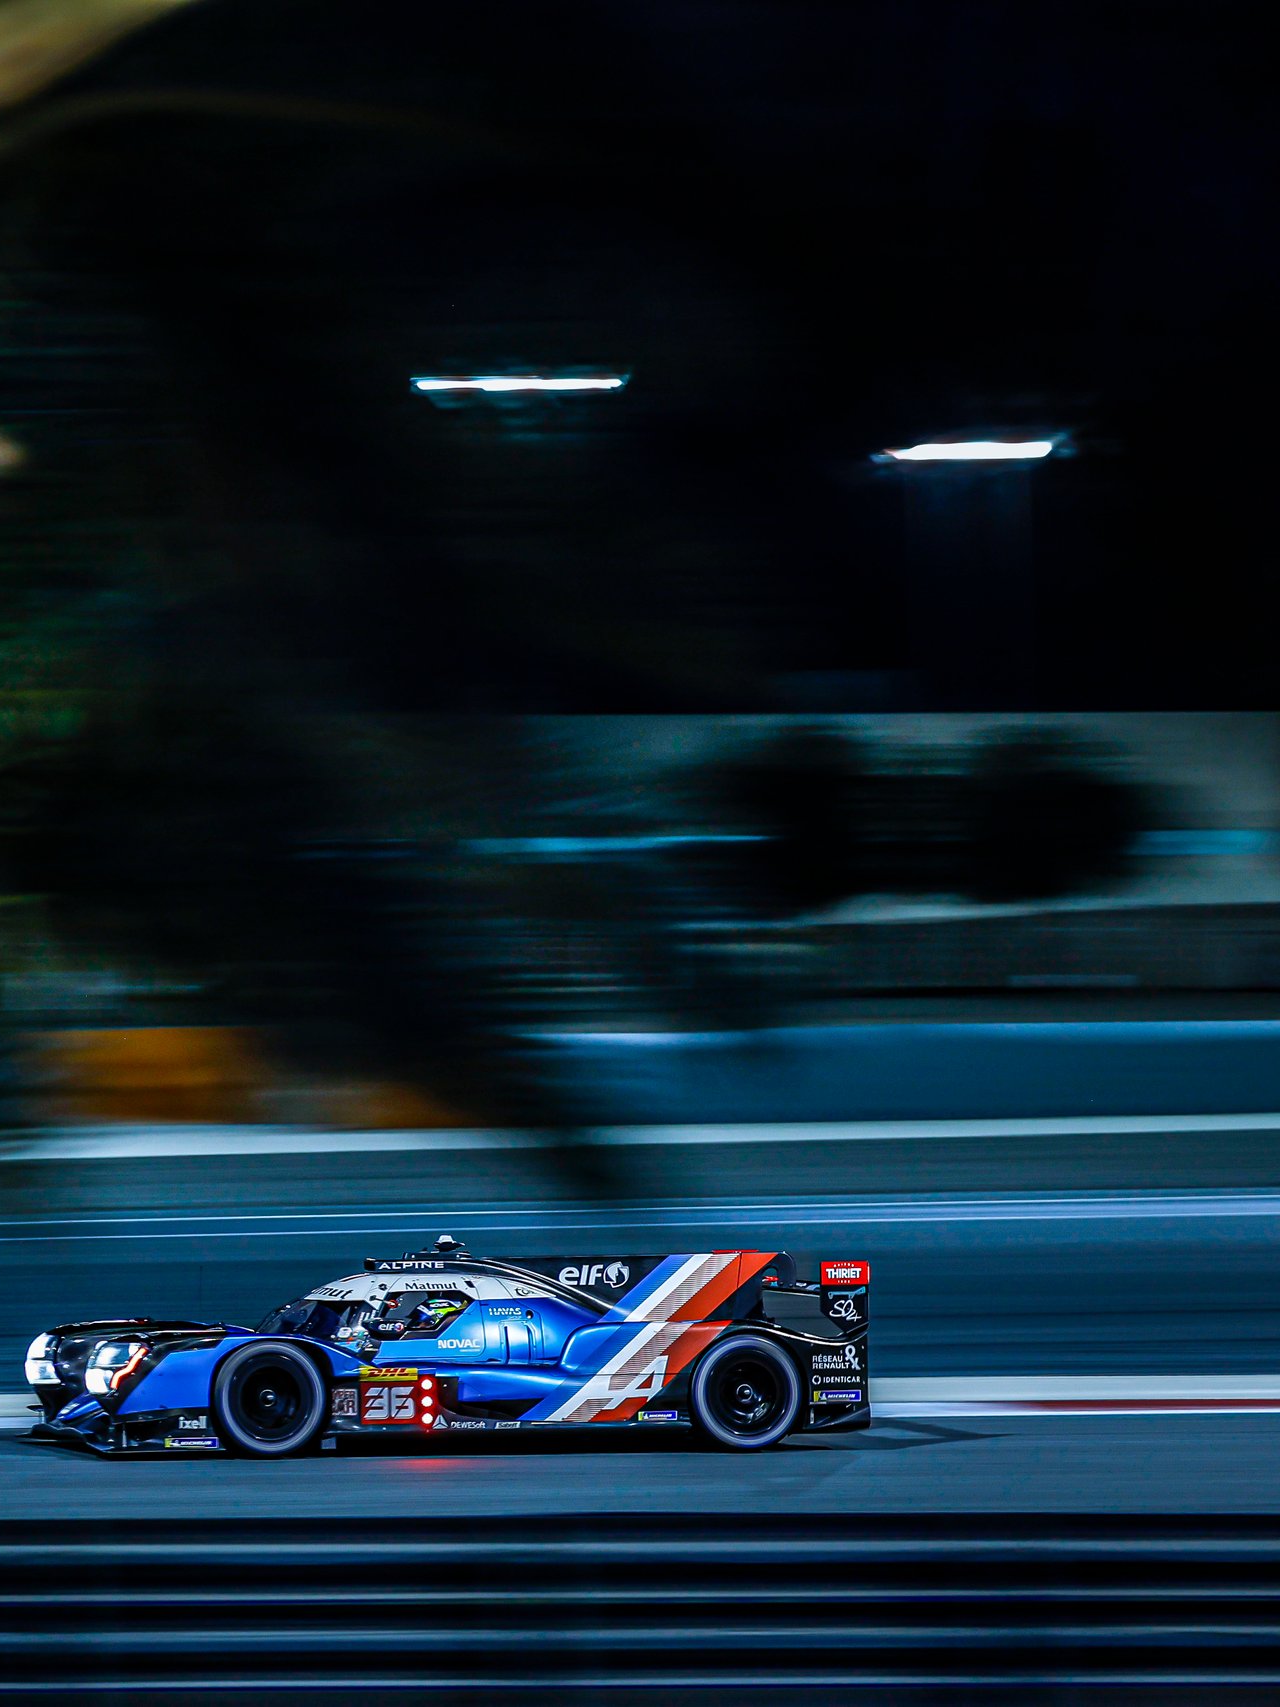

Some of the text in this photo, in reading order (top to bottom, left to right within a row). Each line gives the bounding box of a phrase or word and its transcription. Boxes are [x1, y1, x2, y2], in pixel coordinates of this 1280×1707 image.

[378, 1261, 444, 1270] ALPINE
[559, 1264, 604, 1286] elf
[826, 1268, 862, 1279] THIRIET
[405, 1282, 458, 1291] Matmut
[488, 1307, 522, 1316] HAVAS
[378, 1323, 395, 1331] elf
[437, 1339, 481, 1349] NOVAC
[812, 1353, 843, 1362] RÉSEAU
[812, 1362, 850, 1370] RENAULT
[367, 1367, 408, 1377] DHL
[823, 1376, 860, 1384] IDENTICAR
[364, 1386, 415, 1420] 36
[178, 1416, 207, 1429] ixell
[451, 1421, 486, 1429] DEWESoft
